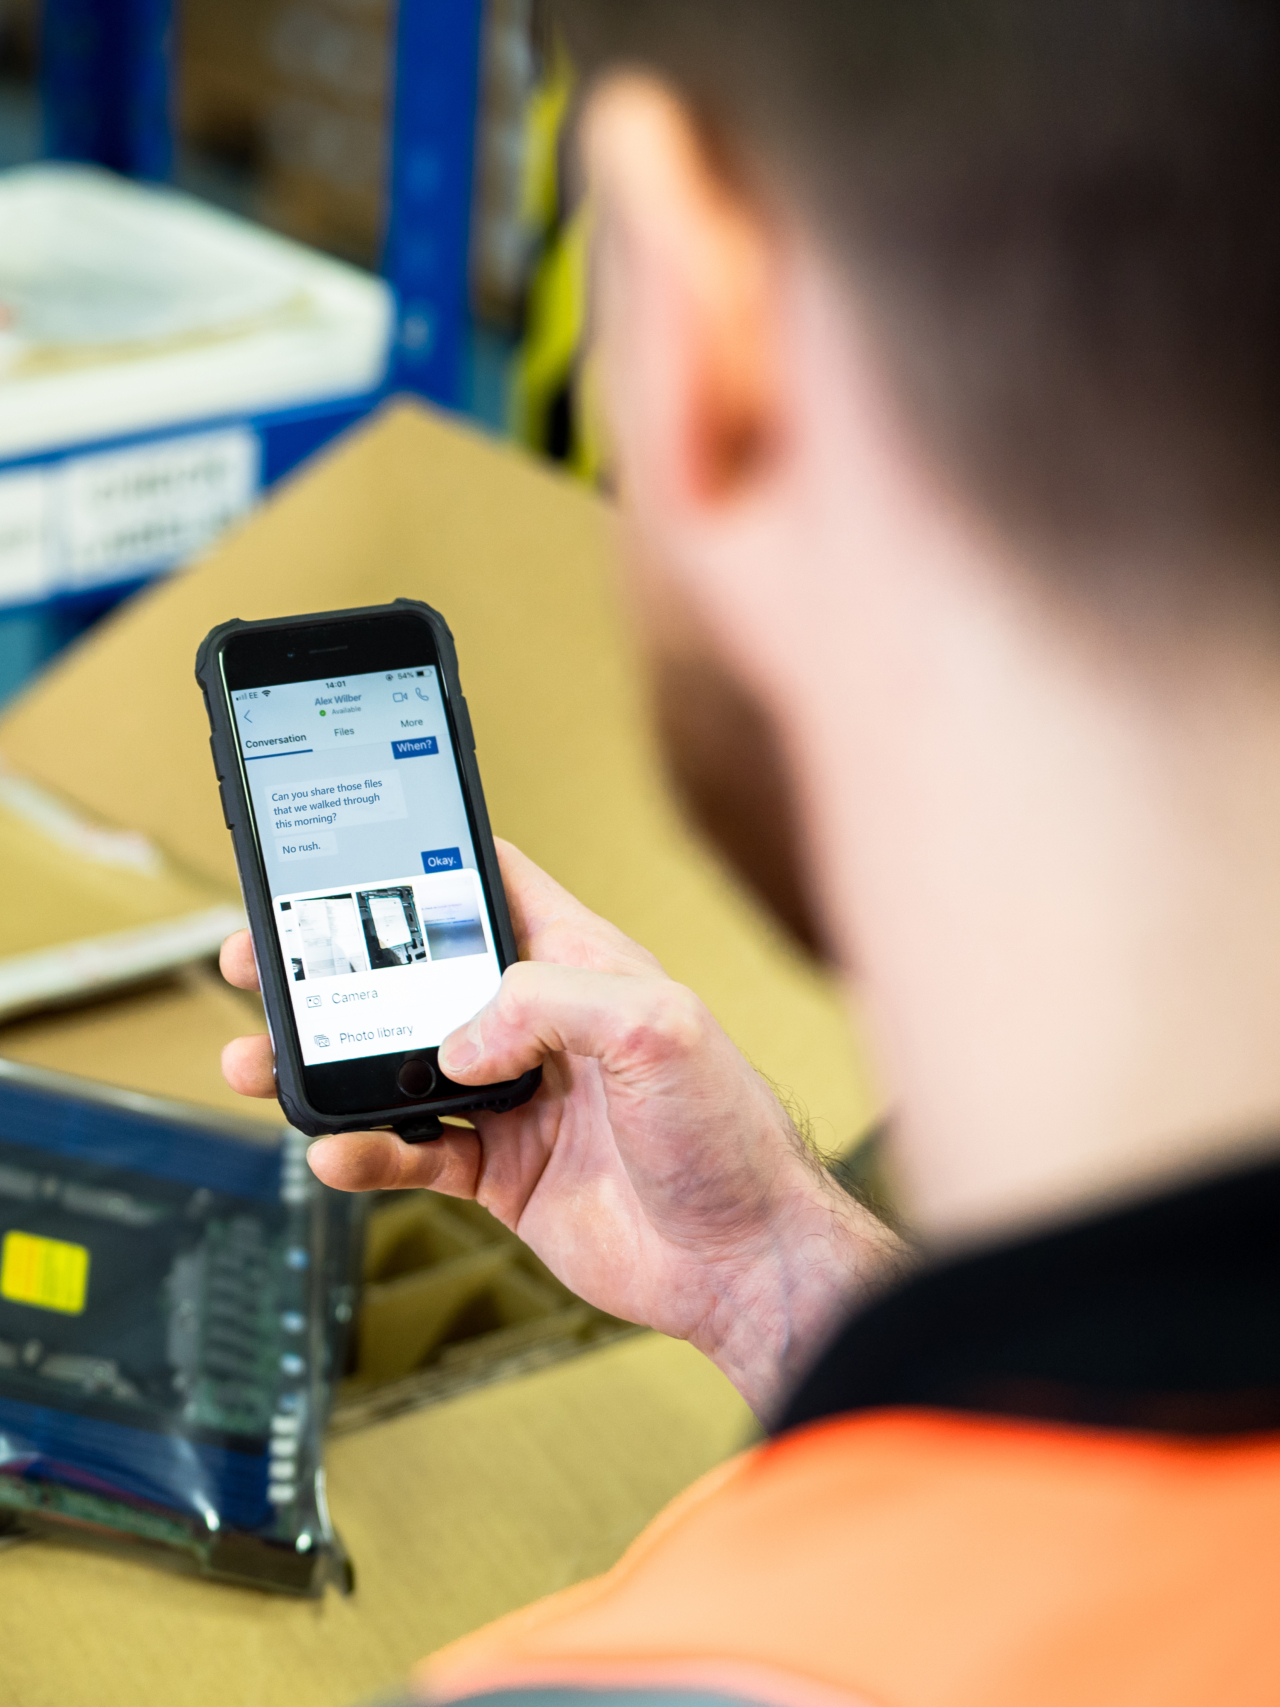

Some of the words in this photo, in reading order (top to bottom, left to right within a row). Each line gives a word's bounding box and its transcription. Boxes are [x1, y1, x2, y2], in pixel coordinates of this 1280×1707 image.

[397, 671, 414, 680] 54%
[325, 679, 347, 689] 14:01
[248, 691, 259, 700] EE
[314, 696, 333, 706] Alex
[333, 693, 362, 704] Wilber
[331, 705, 362, 715] Available
[400, 717, 424, 728] More
[334, 727, 355, 737] Files
[245, 733, 307, 749] Conversation
[396, 739, 433, 753] When?
[271, 792, 290, 802] Can
[290, 791, 309, 801] you
[310, 785, 336, 797] share
[336, 781, 363, 793] those
[363, 778, 383, 789] files
[273, 805, 293, 816] that
[293, 803, 308, 813] we
[309, 798, 342, 810] walked
[342, 792, 381, 807] through
[275, 819, 293, 830] this
[294, 812, 338, 827] morning?
[282, 844, 297, 855] No
[298, 841, 321, 852] rush.
[427, 855, 458, 868] Okay.
[331, 988, 379, 1005] Camera
[339, 1029, 375, 1044] Photo
[376, 1023, 414, 1040] library
